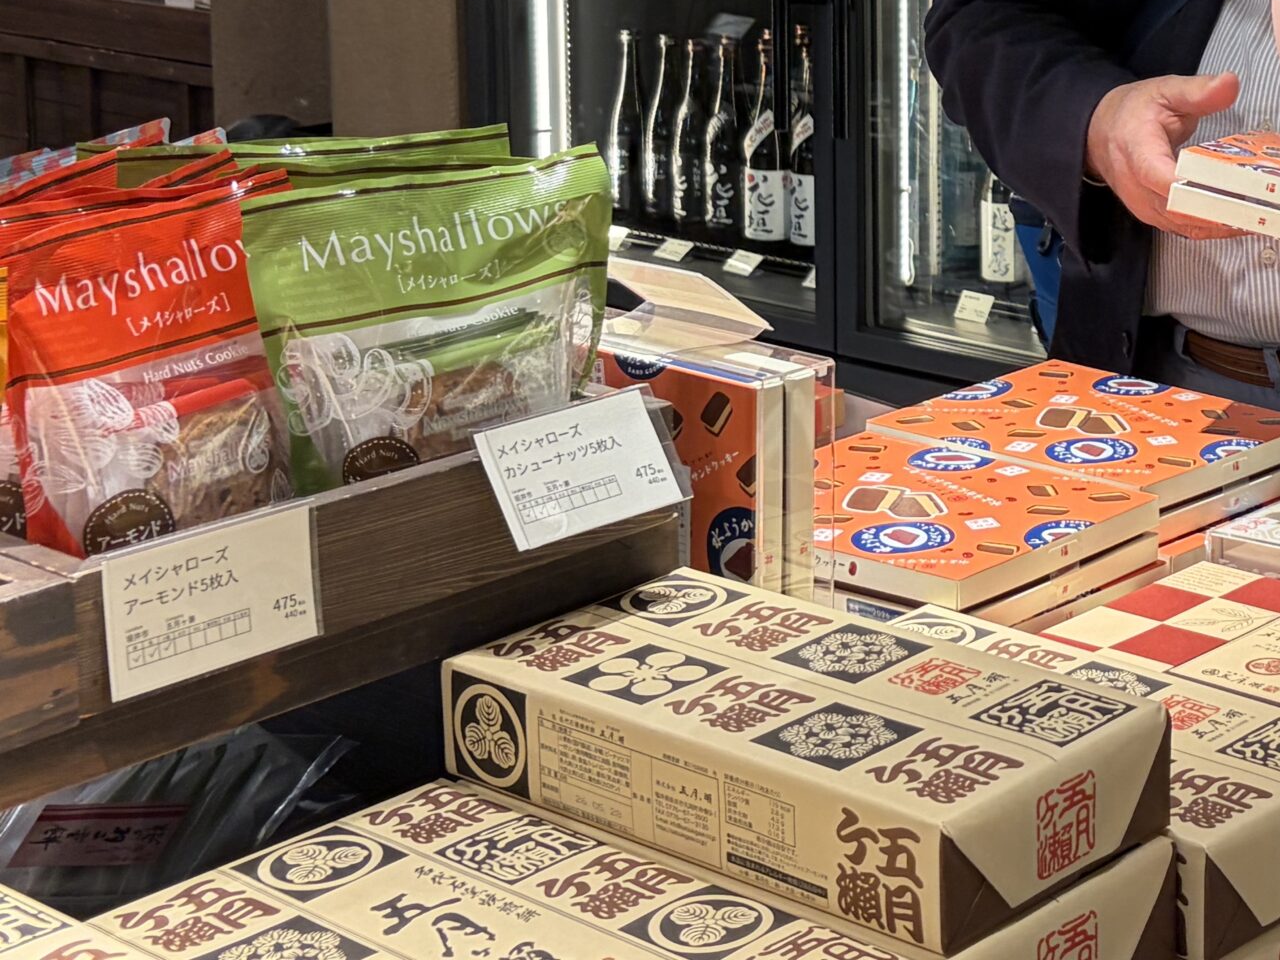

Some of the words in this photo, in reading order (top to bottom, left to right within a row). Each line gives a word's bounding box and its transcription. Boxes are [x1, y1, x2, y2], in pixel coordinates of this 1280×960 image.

[301, 200, 567, 272] Mayshallows
[143, 367, 171, 384] Hard
[175, 358, 204, 376] Nuts
[206, 343, 249, 366] Cookie
[355, 450, 376, 467] Hard
[497, 423, 582, 459] メイシャローズ
[504, 436, 622, 480] カシューナッツ5枚入
[636, 464, 657, 479] 475
[648, 476, 661, 486] 440
[691, 451, 740, 482] サンドクッキー
[97, 519, 162, 551] アーモンド
[123, 546, 229, 590] メイシャローズ
[125, 569, 239, 615] アーモンド5枚入
[273, 594, 298, 612] 475
[284, 609, 298, 619] 440
[486, 619, 632, 672] 五月ヶ瀬
[692, 601, 834, 651] 五月ヶ瀬
[664, 676, 817, 732] 五月ヶ瀬
[1161, 694, 1221, 730] 五月瀬
[865, 737, 1024, 803] 五月ヶ瀬
[361, 785, 512, 844] 五月ヶ瀬
[1036, 770, 1096, 880] 五月ヶ瀬
[535, 852, 695, 920] 五月ヶ瀬
[836, 806, 924, 944] 五月ヶ瀬
